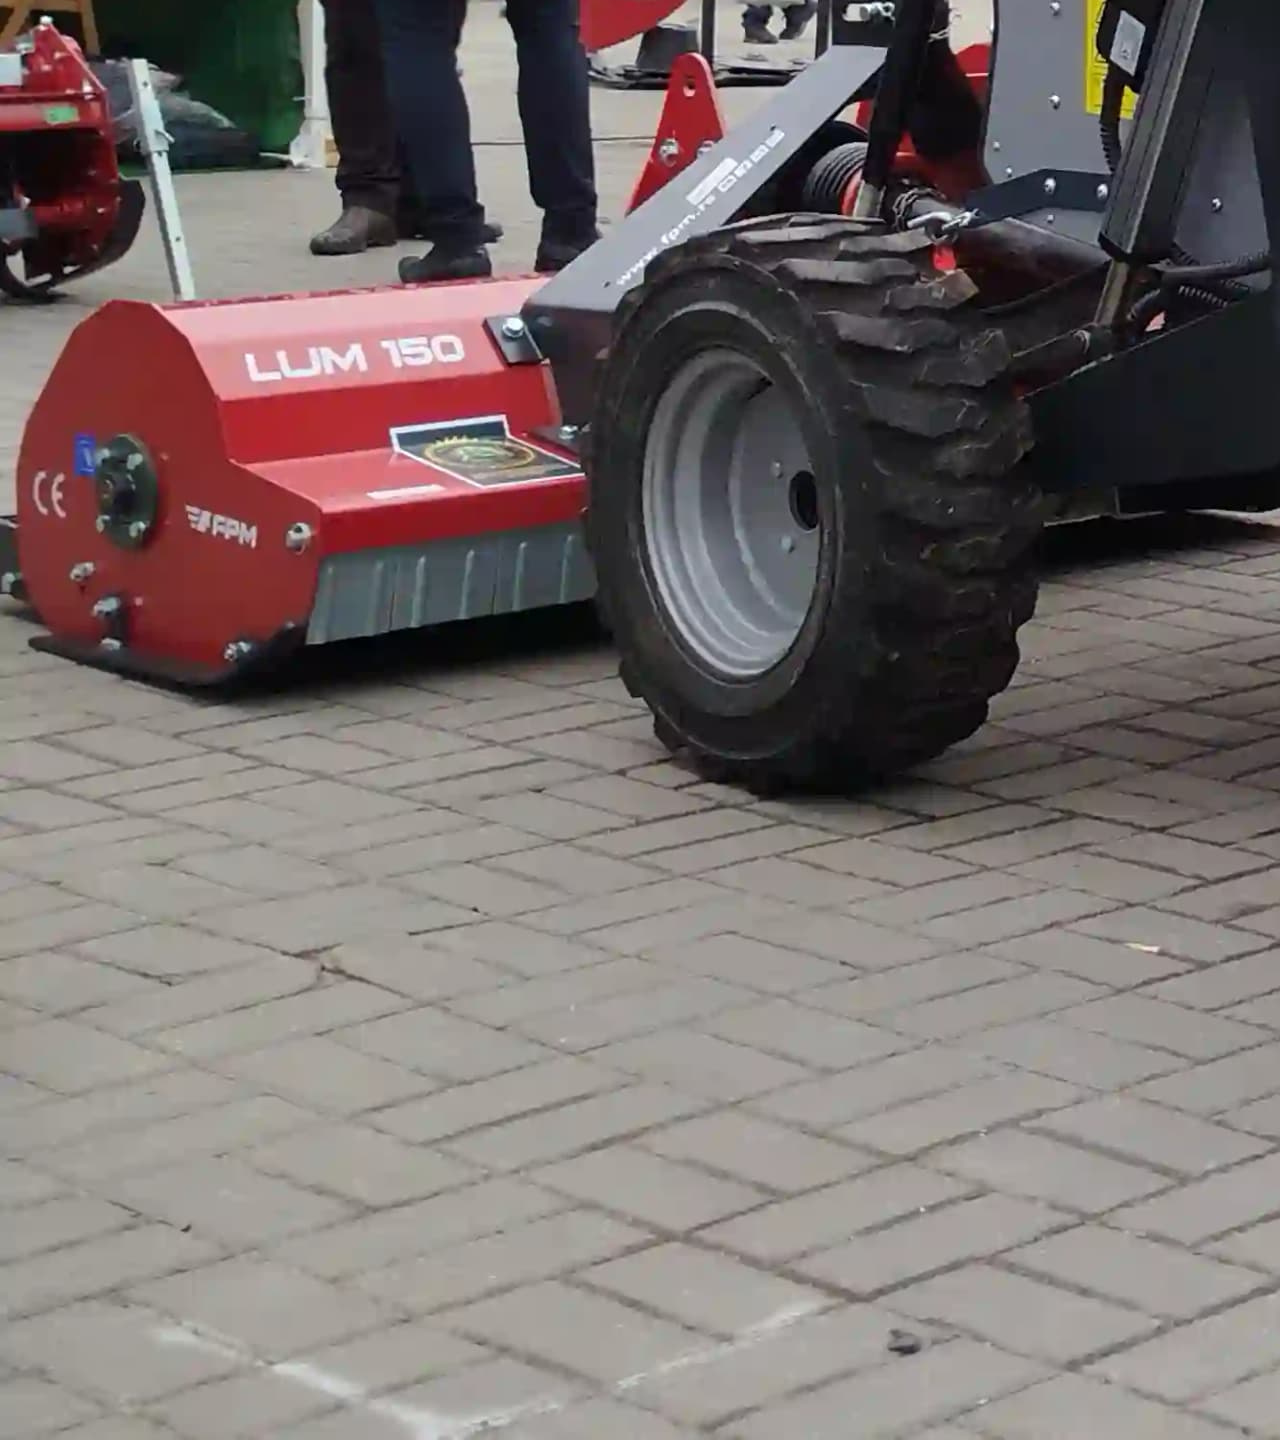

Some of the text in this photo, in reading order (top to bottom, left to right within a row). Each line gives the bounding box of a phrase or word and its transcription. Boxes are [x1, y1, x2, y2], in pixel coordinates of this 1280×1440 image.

[244, 334, 465, 382] LUM 150
[33, 471, 67, 518] CE
[211, 513, 258, 549] FPM
